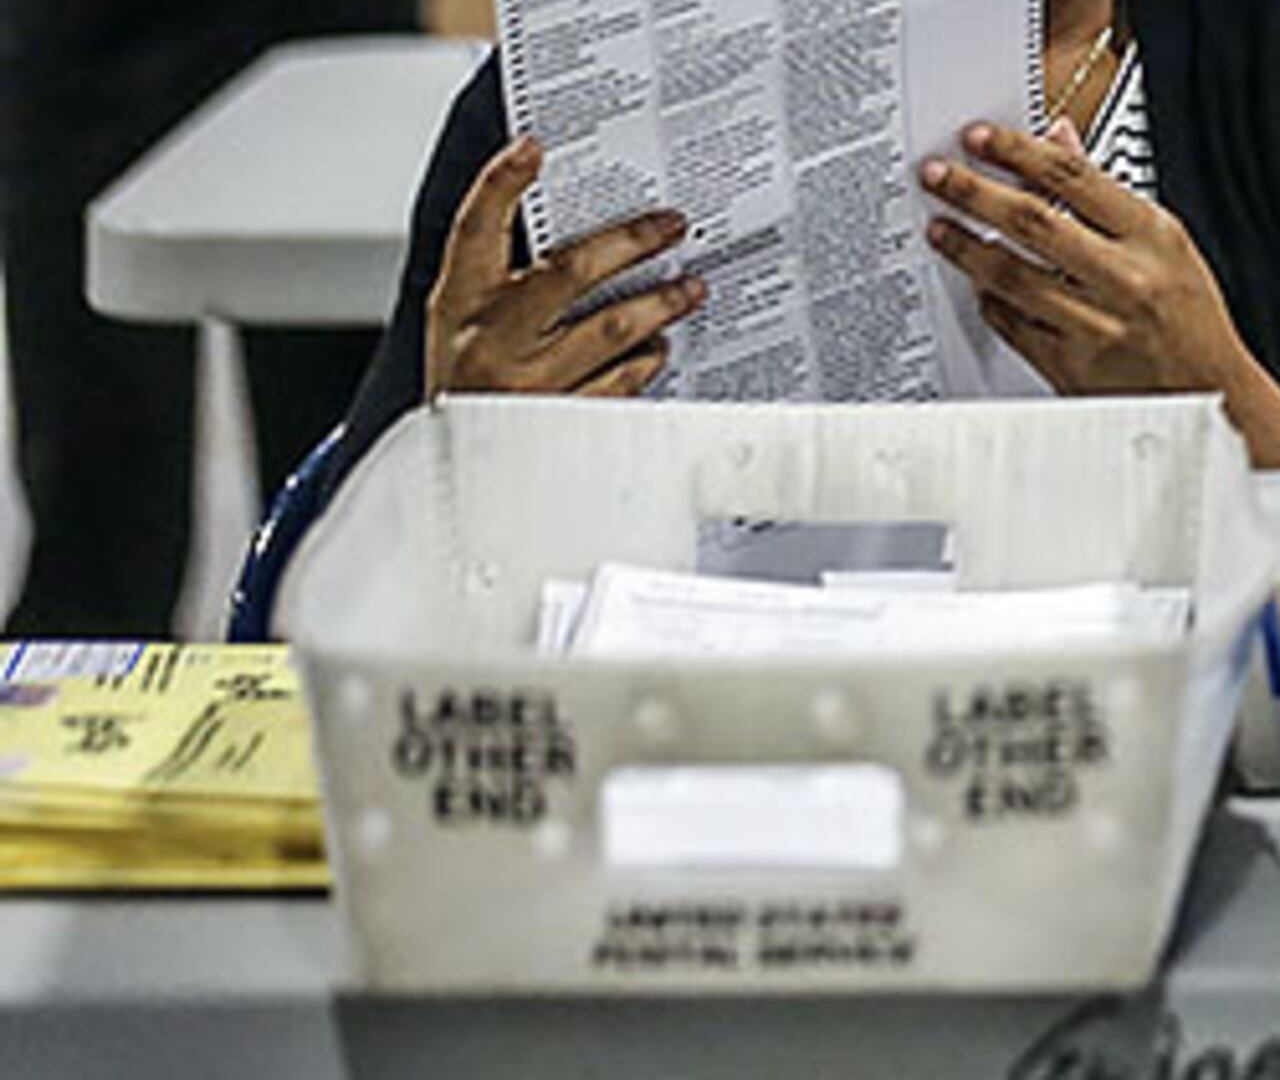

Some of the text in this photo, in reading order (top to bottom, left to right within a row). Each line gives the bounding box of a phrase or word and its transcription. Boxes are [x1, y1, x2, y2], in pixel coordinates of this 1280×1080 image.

[398, 688, 563, 727] LABEL
[931, 684, 1098, 725] LABEL
[393, 732, 576, 776] OTHER
[926, 730, 1109, 774] OTHER
[433, 784, 547, 825] END
[965, 780, 1078, 821] END
